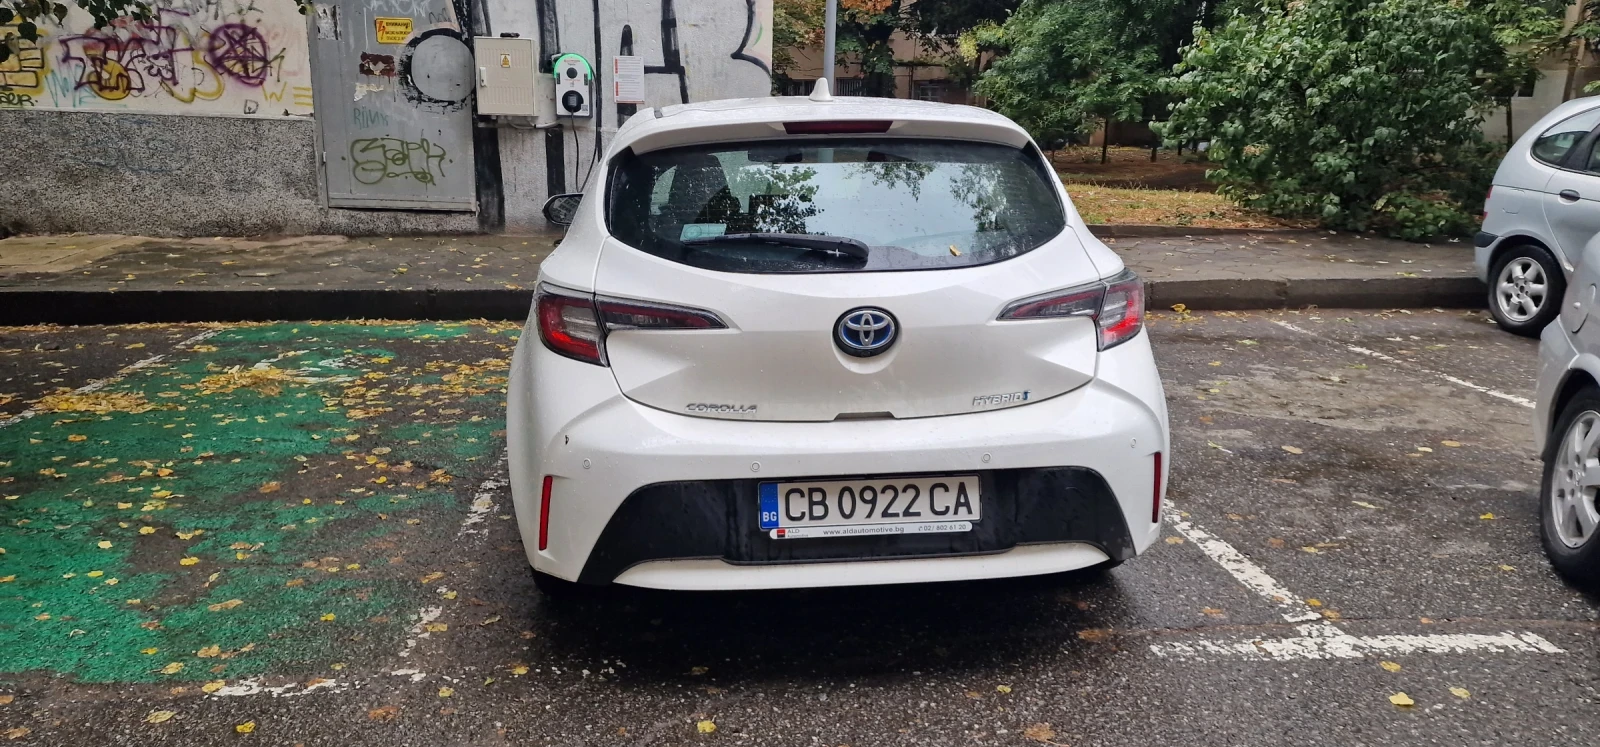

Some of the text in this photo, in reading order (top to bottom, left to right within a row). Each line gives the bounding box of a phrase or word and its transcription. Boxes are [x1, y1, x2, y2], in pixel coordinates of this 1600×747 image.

[685, 403, 757, 413] COROLLA
[785, 481, 973, 521] CB 0922 CA
[762, 511, 777, 522] BG
[823, 526, 905, 535] www.aldautomotive.bg
